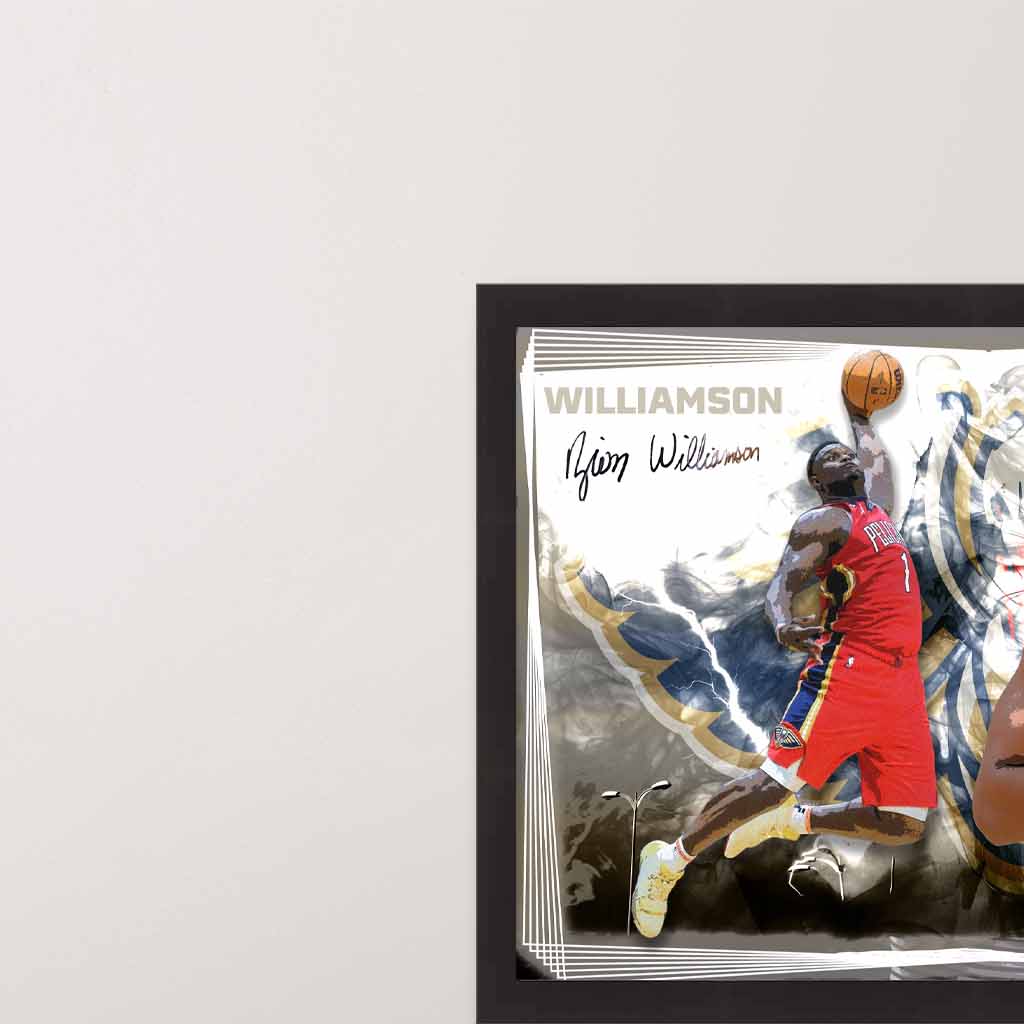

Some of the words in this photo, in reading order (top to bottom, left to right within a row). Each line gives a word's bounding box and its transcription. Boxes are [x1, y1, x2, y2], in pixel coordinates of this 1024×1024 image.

[543, 386, 783, 415] WILLIAMSON
[650, 432, 760, 473] Williamson
[901, 552, 911, 593] 1
